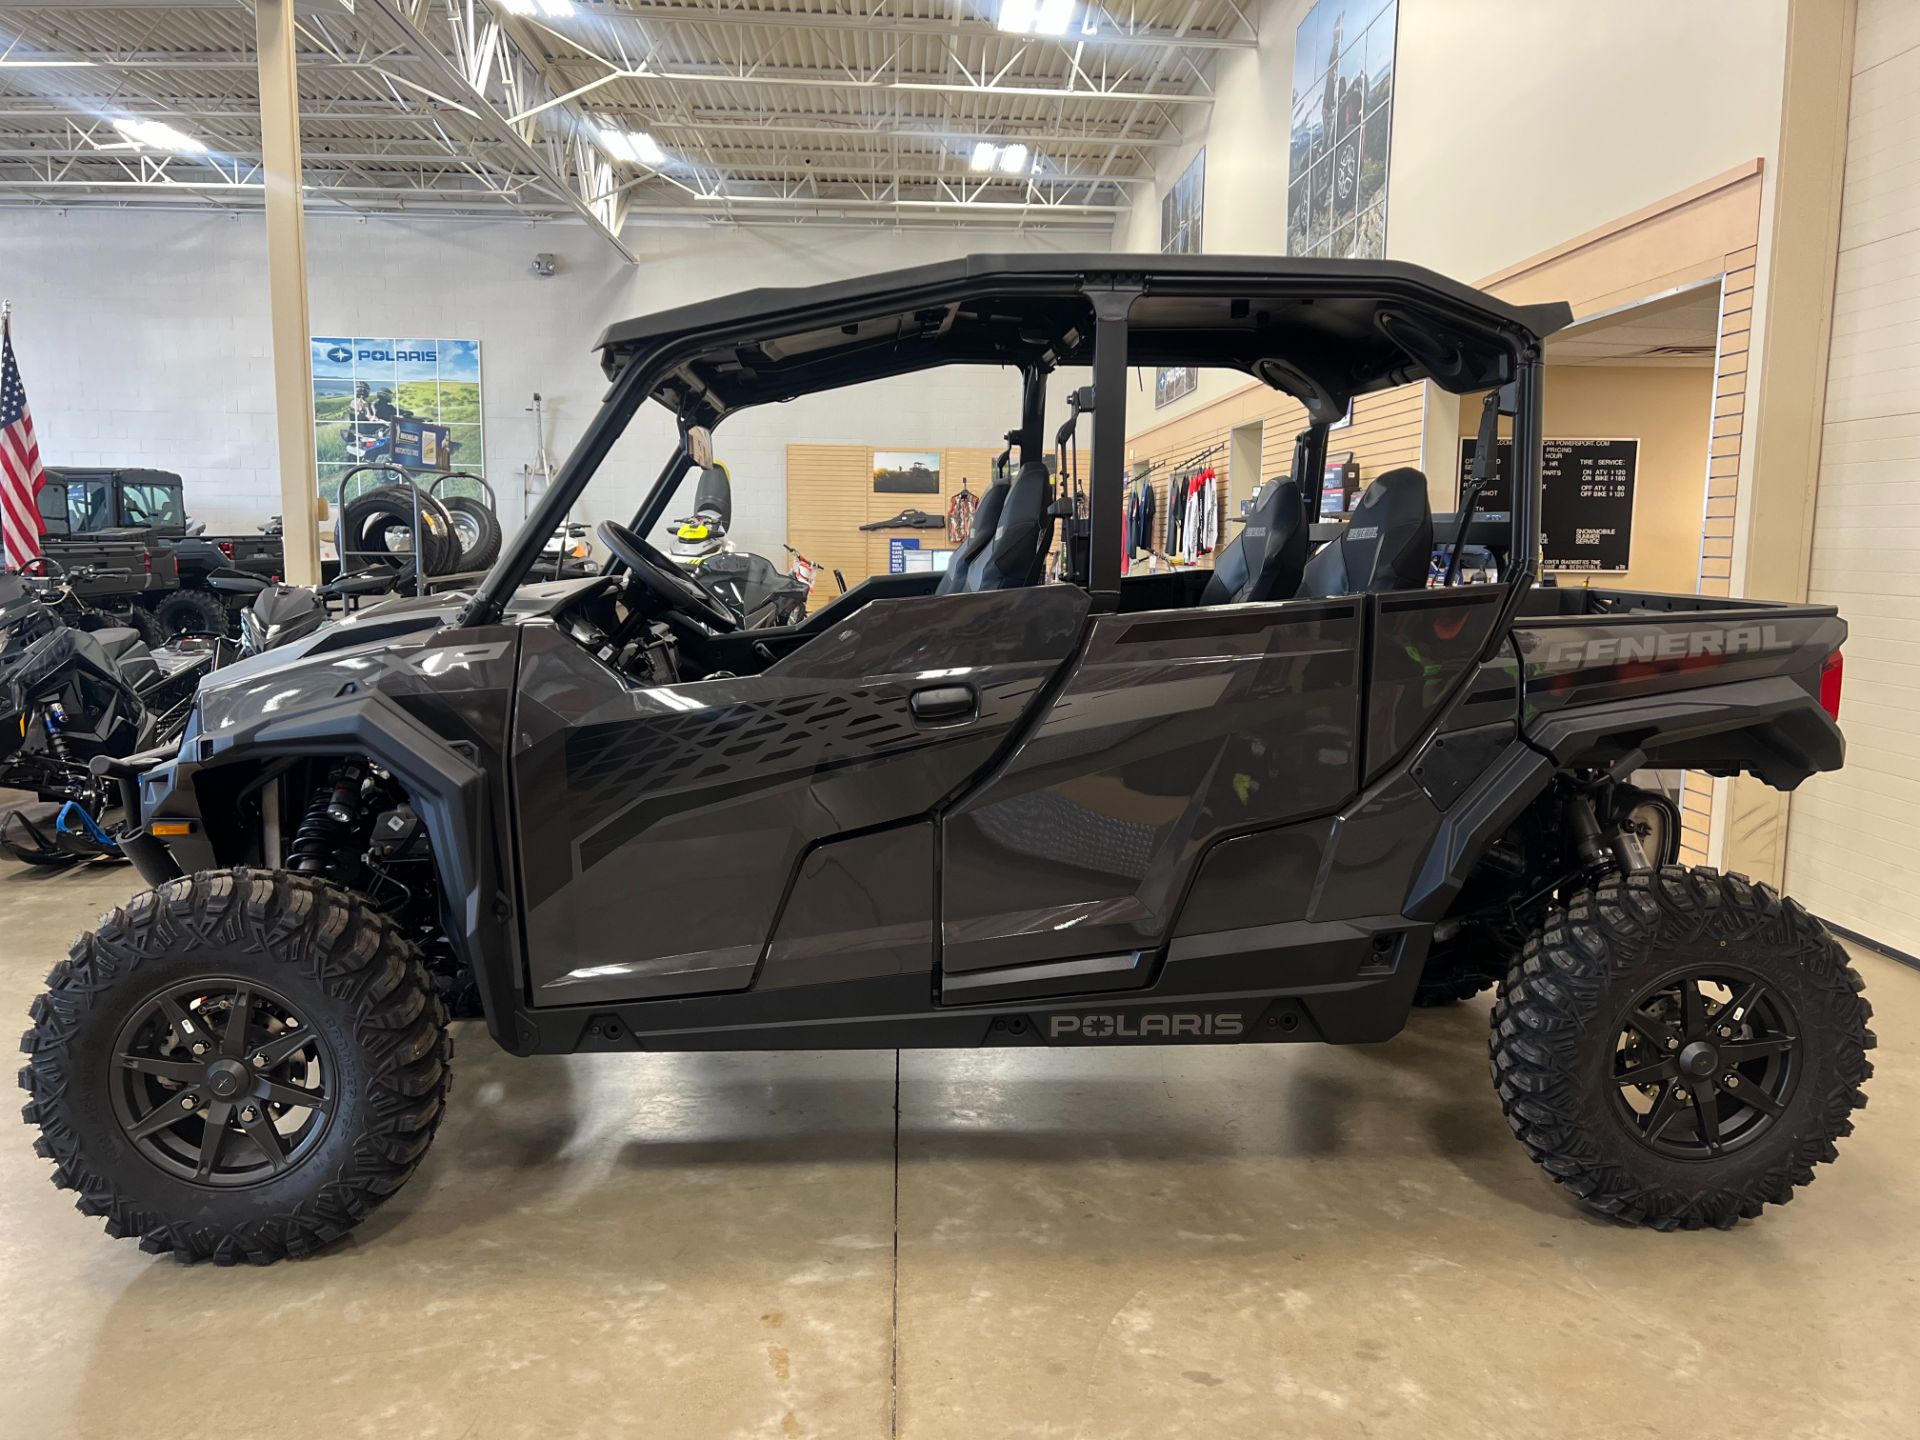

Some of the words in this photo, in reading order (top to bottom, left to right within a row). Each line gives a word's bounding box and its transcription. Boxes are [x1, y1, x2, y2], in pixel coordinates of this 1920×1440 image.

[358, 350, 437, 362] POLARIS
[1545, 625, 1793, 670] GENERAL
[1050, 1013, 1244, 1038] POLARIS
